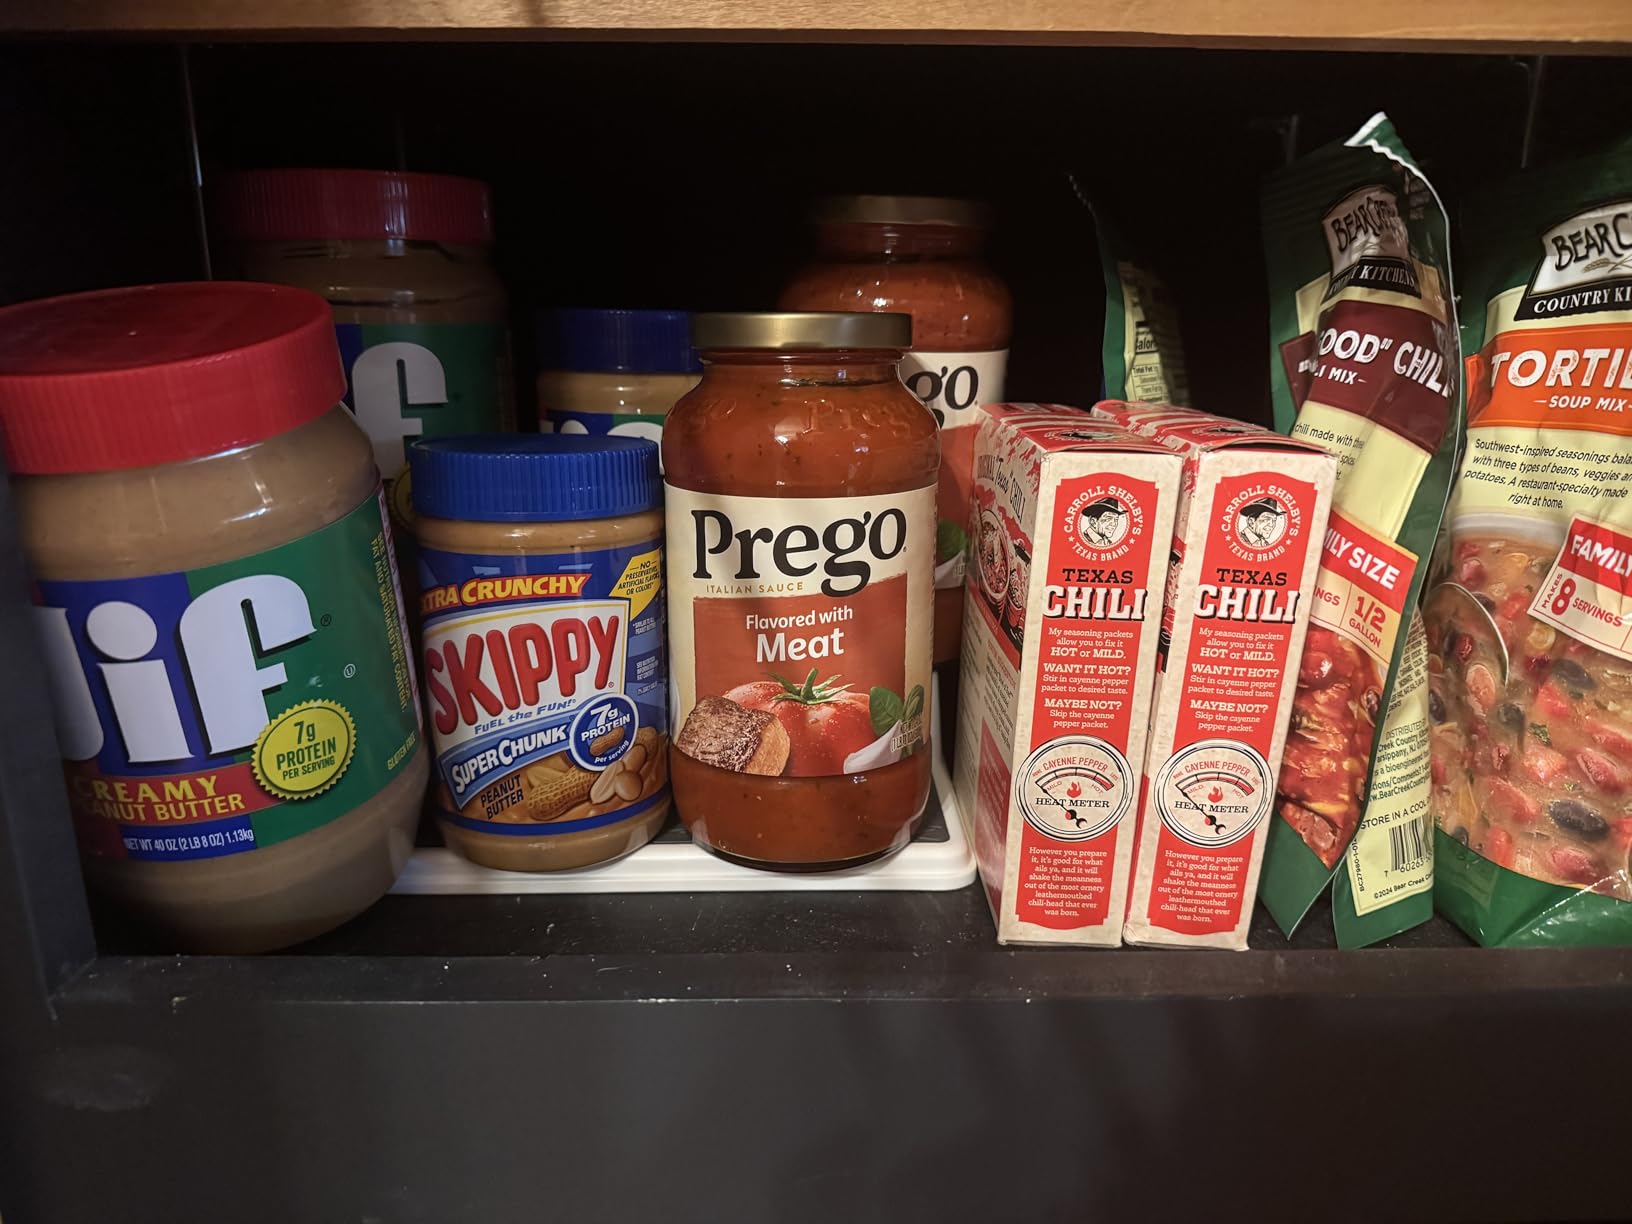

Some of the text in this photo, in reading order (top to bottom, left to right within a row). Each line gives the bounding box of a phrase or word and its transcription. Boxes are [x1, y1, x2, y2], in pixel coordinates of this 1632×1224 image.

[1534, 289, 1611, 314] COUNTRY
[1549, 395, 1628, 412] SOUP MIX
[1310, 428, 1334, 441] made
[1336, 434, 1352, 447] with
[1475, 438, 1611, 465] Southwest-inspired seasonings
[1473, 455, 1622, 482] with three types of beans, veggies
[1463, 469, 1628, 498] potatoes. A restaurant-specialty made
[1063, 486, 1143, 535] CARROLL SHELBY'S
[1221, 485, 1301, 537] CARROLL SHELBY'S
[1508, 493, 1564, 509] right at home.
[691, 508, 907, 597] Prego
[1072, 542, 1129, 561] TEXAS BRAND
[1228, 542, 1286, 562] TEXAS BRAND
[640, 560, 651, 570] NO
[1062, 568, 1133, 584] TEXAS
[1348, 547, 1400, 590] SIZE
[706, 581, 804, 594] ITALIAN SAUCE
[1216, 567, 1287, 586] TEXAS
[462, 575, 588, 604] CRUNCHY
[1541, 573, 1563, 609] MAKES
[1042, 585, 1149, 621] CHILI
[1193, 584, 1300, 624] CHILI
[1551, 578, 1623, 627] 8 SERVINGS
[745, 605, 853, 630] Flavored with
[1355, 596, 1386, 633] 1/2
[1048, 627, 1133, 639] My seasoning packets
[1056, 638, 1077, 646] allow
[1078, 640, 1094, 648] you
[1105, 639, 1116, 647] fix
[1117, 639, 1123, 647] it
[1349, 617, 1381, 648] GALLON
[757, 627, 844, 663] Meat
[1050, 647, 1126, 659] HOT or MILD.
[427, 615, 620, 735] SKIPPY
[1042, 674, 1129, 686] Stir in cayenne pepper
[1043, 663, 1131, 676] WANT IT HOT?
[1041, 685, 1067, 693] packet
[1078, 686, 1106, 694] desired
[1107, 687, 1128, 695] taste.
[1044, 698, 1122, 710] MAYBE NOT?
[1050, 709, 1115, 720] Skip the cayenne
[474, 698, 573, 735] FUEL the FUN!
[590, 703, 619, 728] 7g
[1053, 720, 1108, 729] pepper packet.
[294, 721, 316, 745] 7g
[581, 714, 631, 742] PROTEIN
[276, 737, 337, 770] PROTEIN
[608, 740, 630, 762] serving
[282, 756, 336, 781] PER SERVING
[1043, 757, 1109, 773] CAYENNE PEPPER
[480, 774, 521, 808] PEANUT
[154, 793, 246, 821] BUTTER
[486, 790, 524, 821] BUTTER
[1035, 798, 1110, 808] HEAT METER
[1360, 814, 1390, 830] STORE
[1392, 811, 1400, 821] IN
[1403, 808, 1409, 817] A
[139, 838, 152, 851] WT
[154, 838, 165, 851] 40
[165, 838, 178, 851] OZ
[179, 837, 188, 852] (2
[189, 838, 200, 851] LB
[201, 837, 208, 848] 8
[209, 833, 225, 847] OZ)
[225, 828, 254, 844] 1.13kg
[1029, 846, 1107, 858] However you prepare
[1040, 856, 1052, 864] it's
[1053, 857, 1071, 865] good
[1072, 857, 1084, 865] for
[1084, 857, 1104, 866] what
[1029, 873, 1051, 881] shake
[1049, 866, 1060, 874] ya,
[1035, 890, 1093, 899] leathermouthed
[1047, 882, 1060, 890] the
[1080, 885, 1105, 893] ornery
[1028, 899, 1064, 907] chili-head
